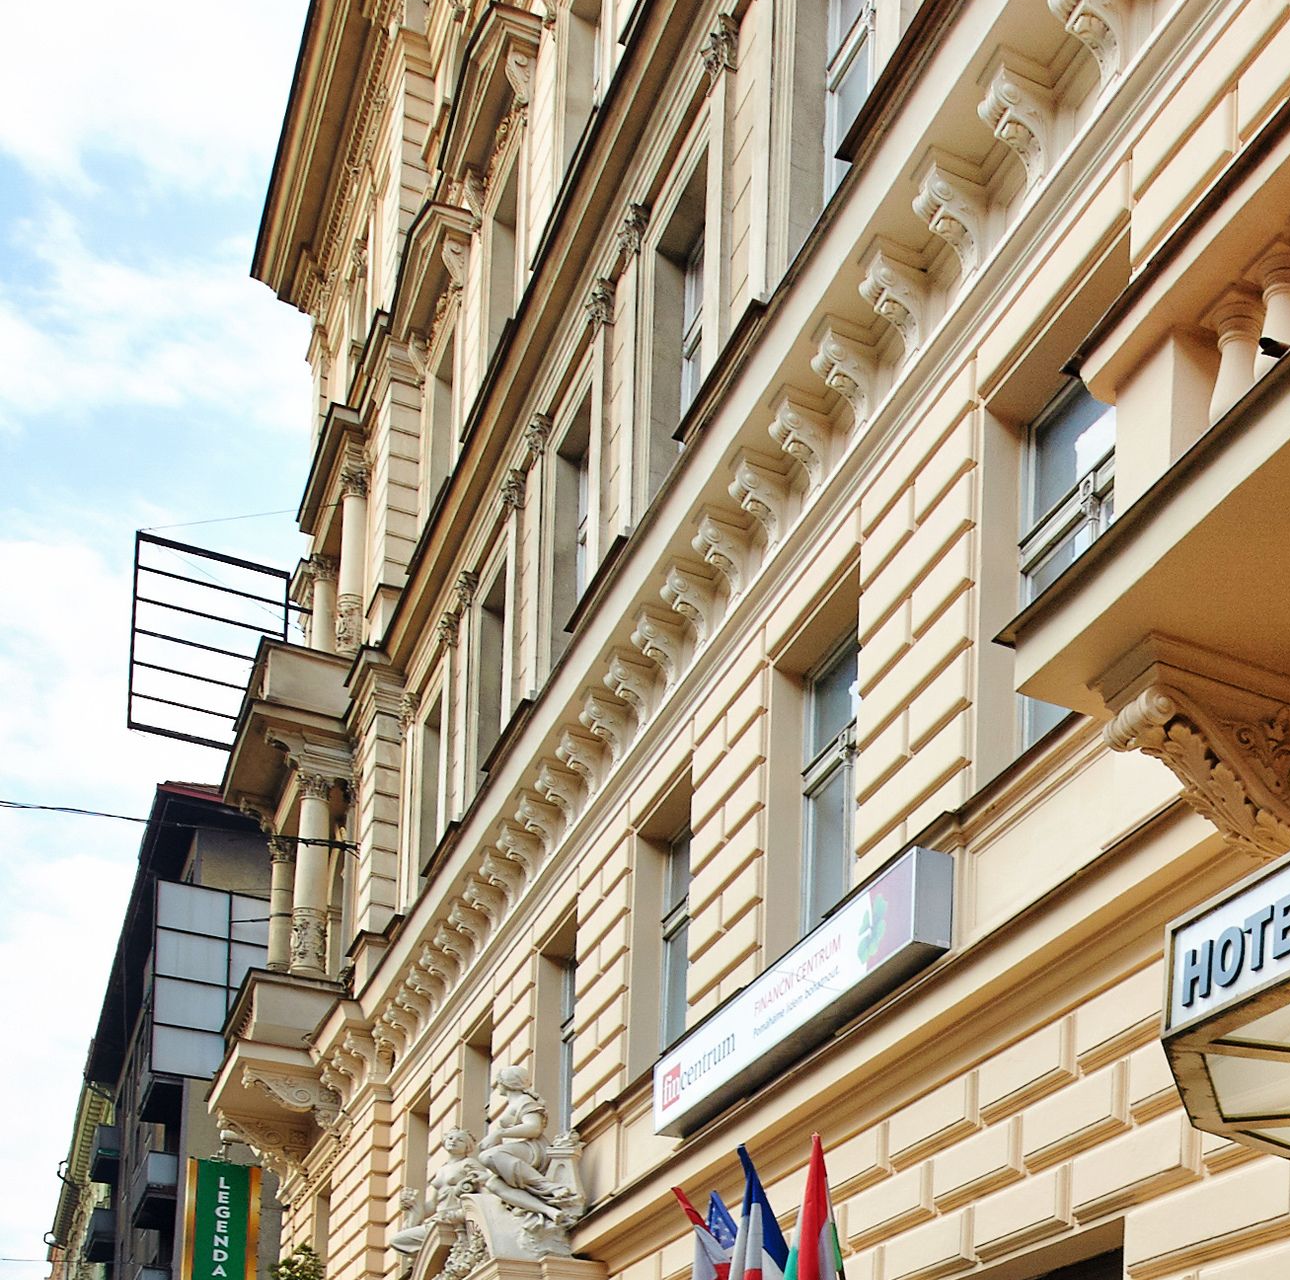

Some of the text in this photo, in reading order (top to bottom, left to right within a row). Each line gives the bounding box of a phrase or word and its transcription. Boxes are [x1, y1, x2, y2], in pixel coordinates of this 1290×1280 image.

[796, 933, 842, 983] CENTRUM
[662, 1032, 736, 1111] fincentrum
[211, 1176, 231, 1278] LEGENDA
